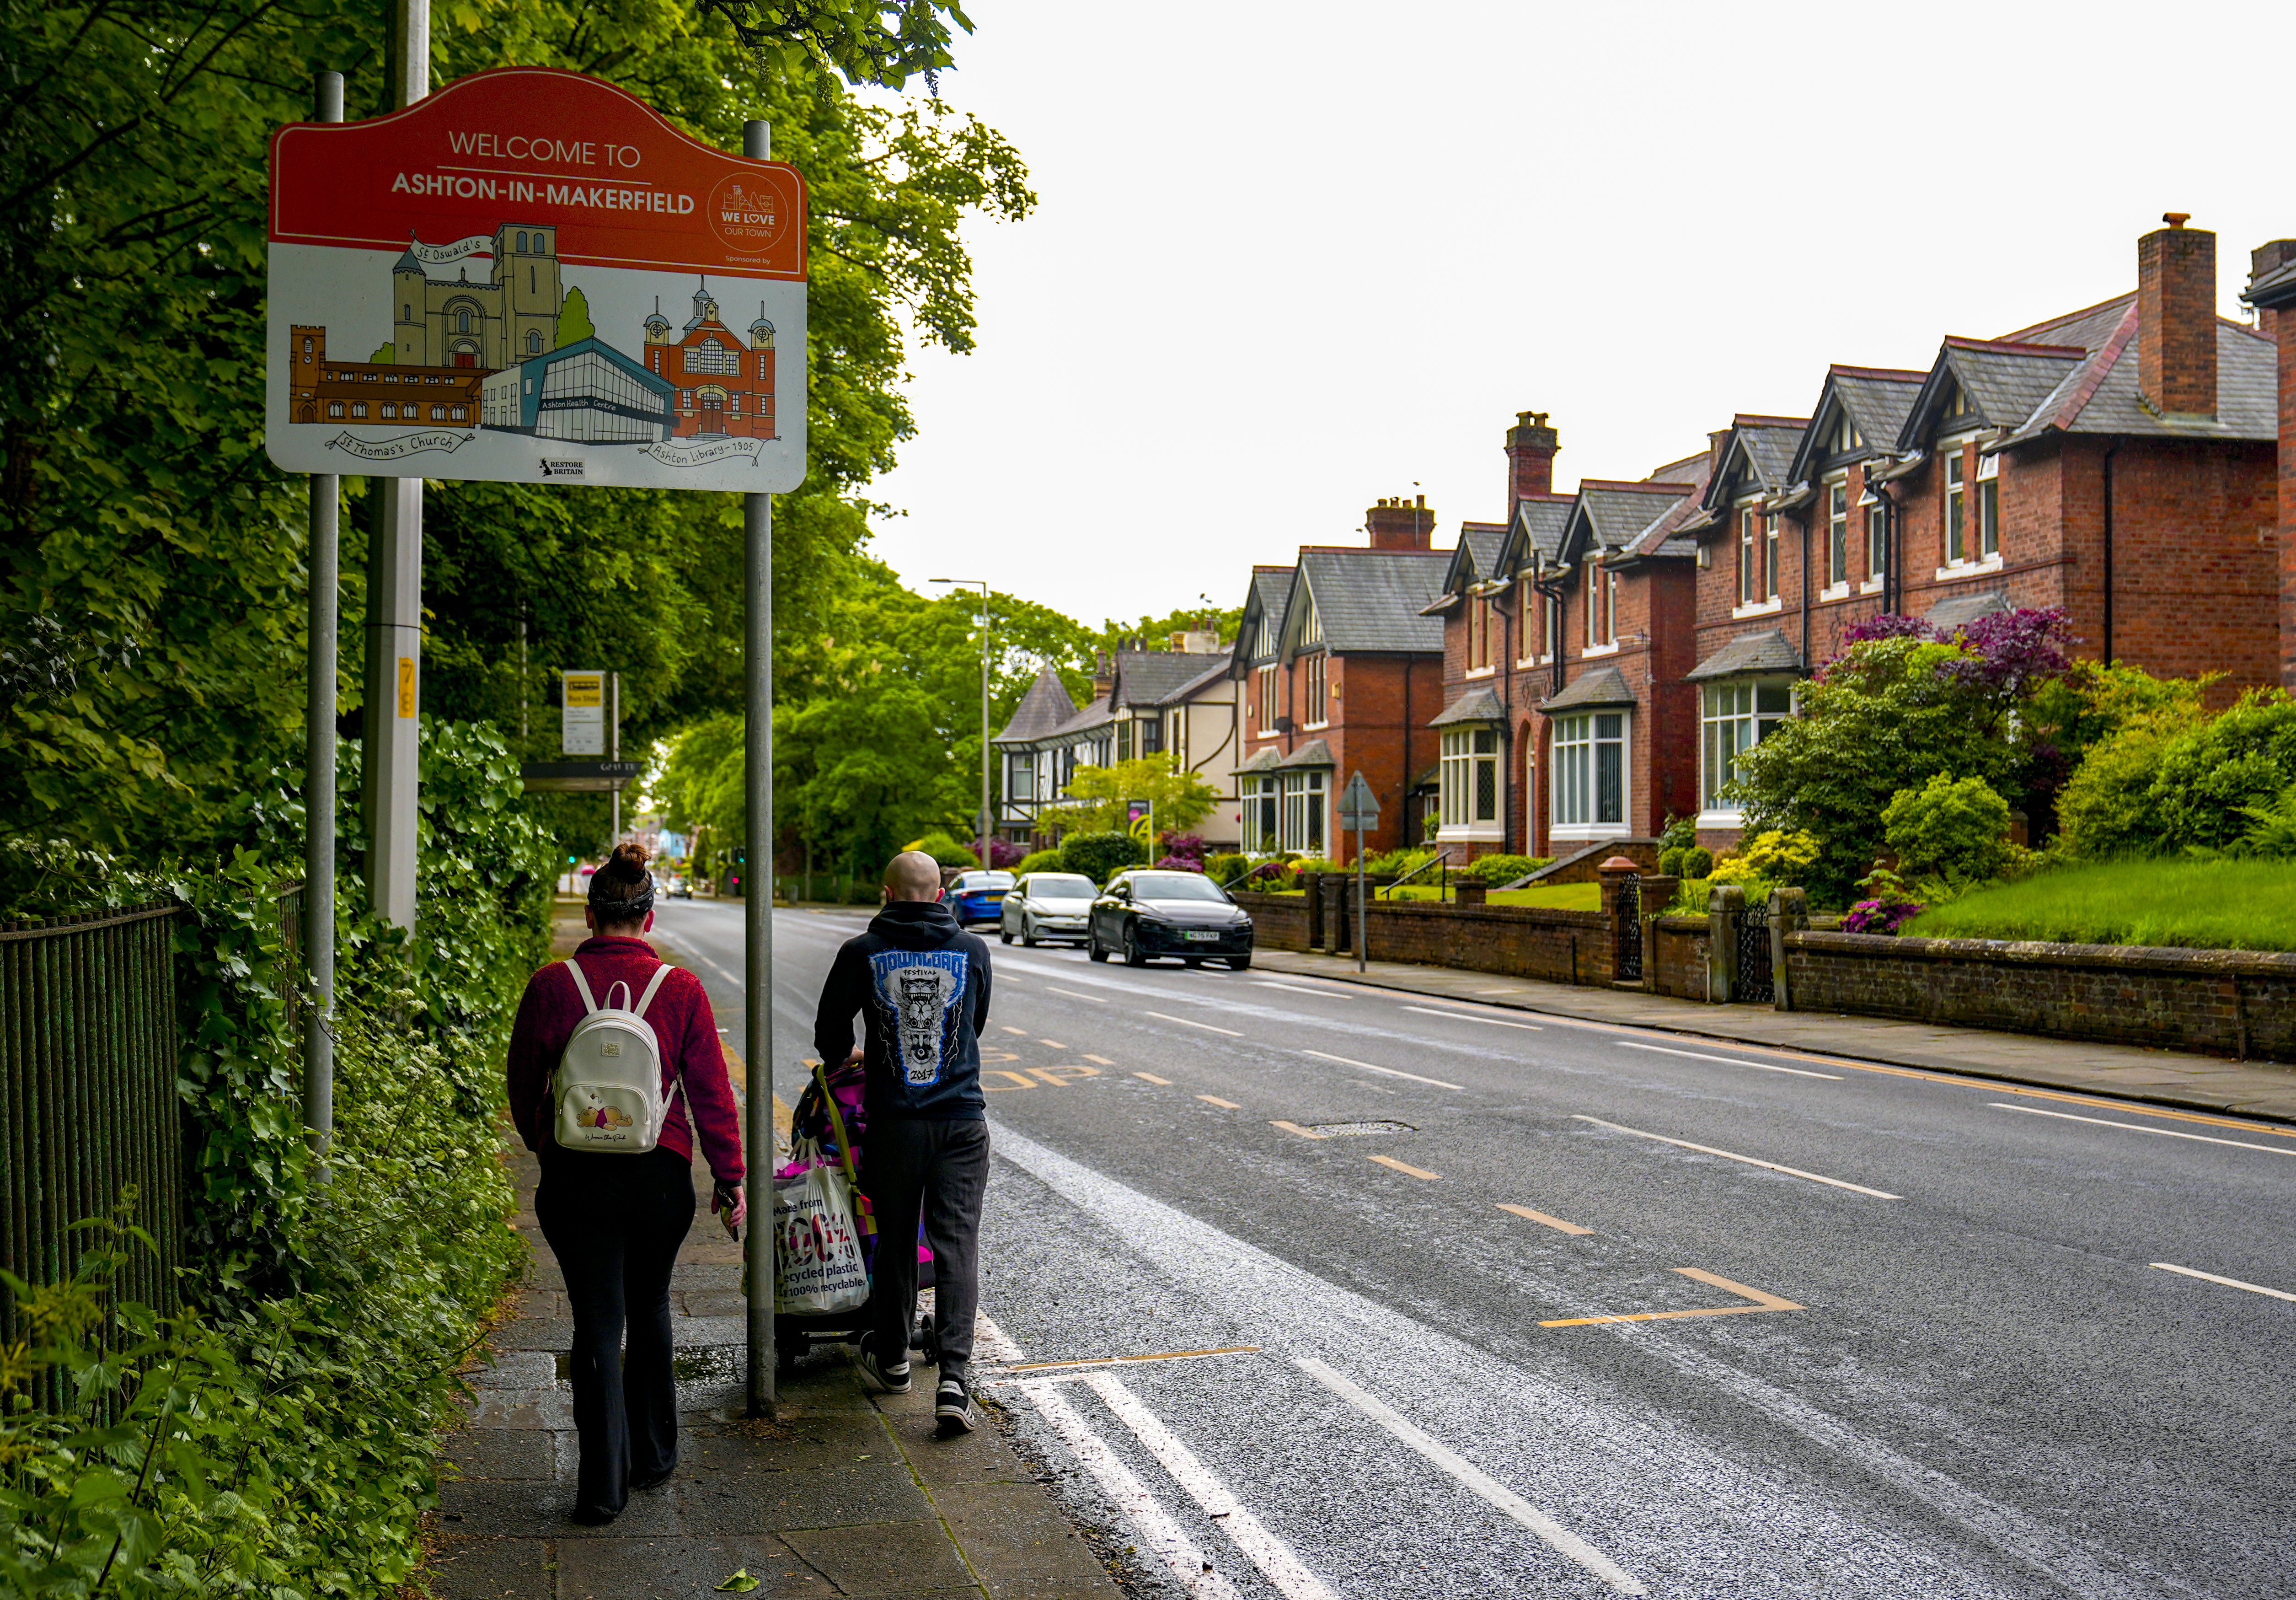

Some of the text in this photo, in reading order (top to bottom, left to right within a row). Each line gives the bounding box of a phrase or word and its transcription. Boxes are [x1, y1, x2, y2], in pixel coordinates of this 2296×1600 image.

[449, 130, 641, 168] WELCOME TO
[391, 172, 695, 215] ASHTON-IN-MAKERFIELD
[721, 212, 740, 223] WE
[724, 227, 771, 238] OUR TOWN
[417, 239, 481, 260] St Oswald's
[567, 398, 589, 407] Health
[594, 400, 616, 411] Centre
[340, 436, 452, 456] St Thomas's Church
[653, 446, 687, 464] Ashton
[732, 442, 754, 451] 1905
[874, 952, 963, 992] DOWNLOAD
[910, 1069, 934, 1080] 2017
[800, 1197, 823, 1211] from
[784, 1262, 859, 1284] ecycled plastic
[789, 1284, 819, 1297] 100%
[821, 1278, 866, 1293] recyclable.
